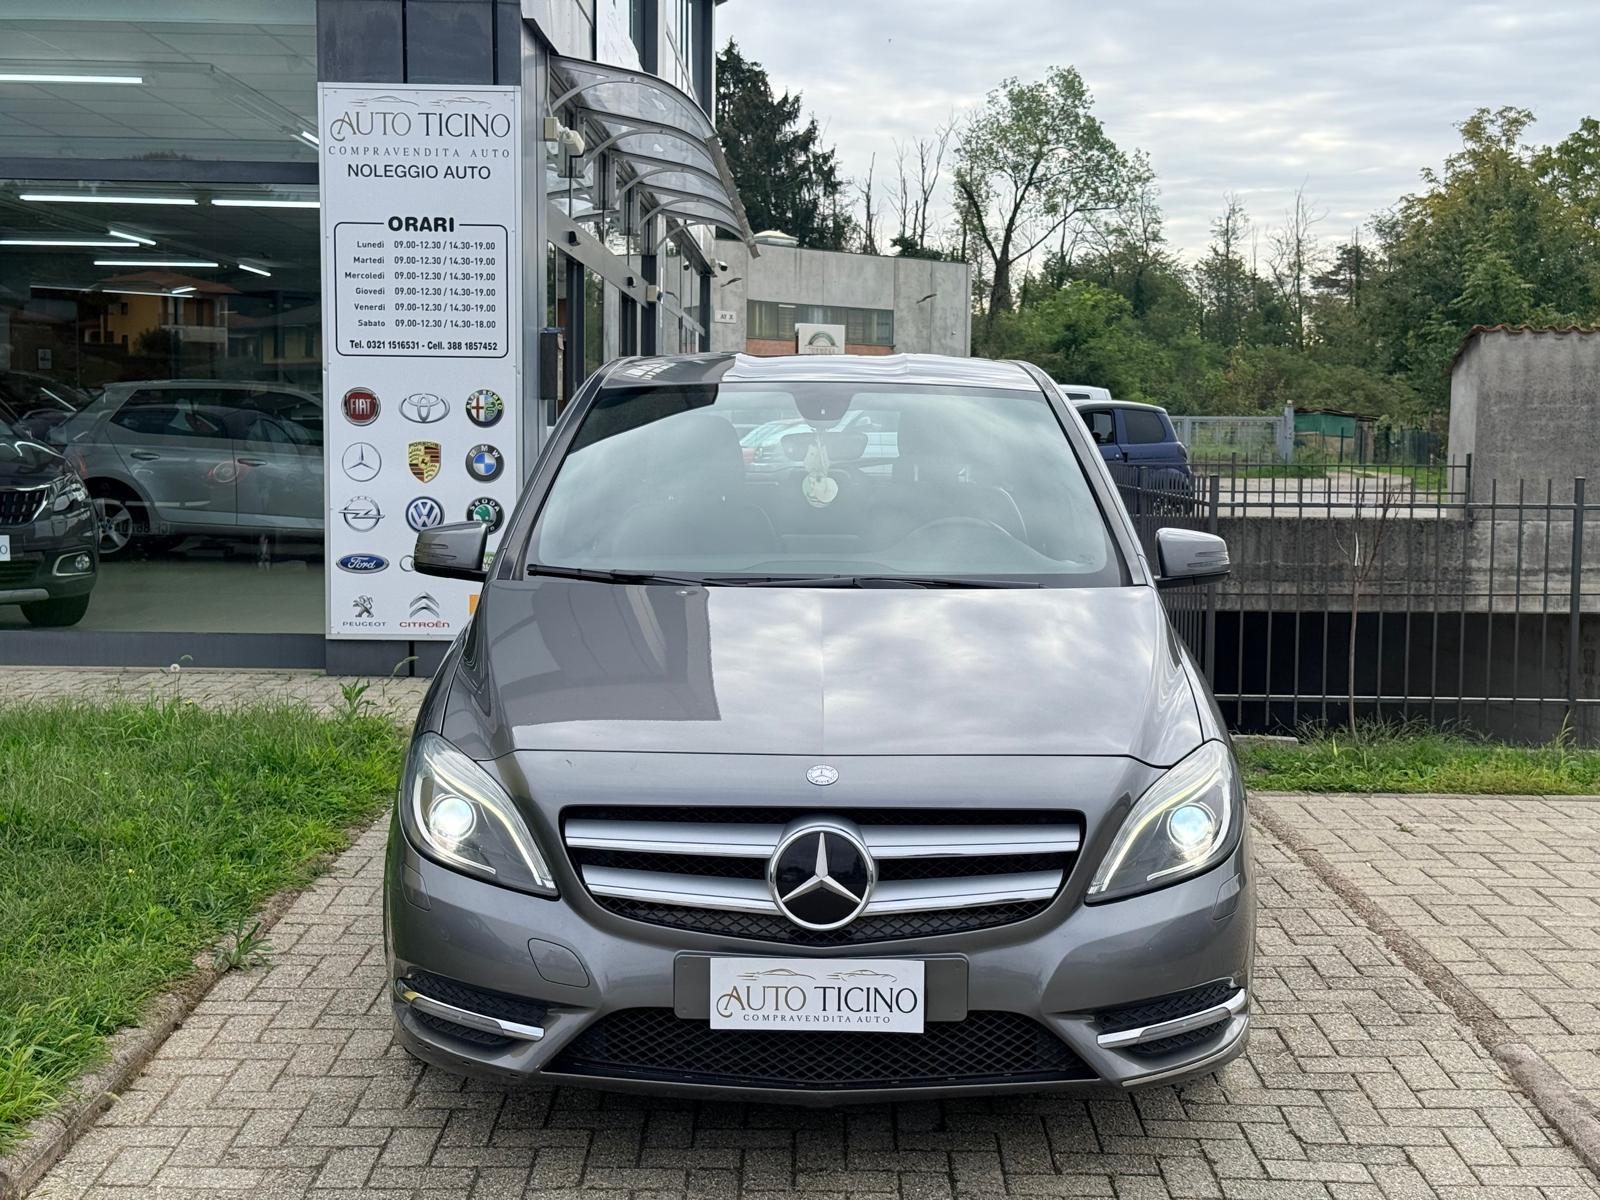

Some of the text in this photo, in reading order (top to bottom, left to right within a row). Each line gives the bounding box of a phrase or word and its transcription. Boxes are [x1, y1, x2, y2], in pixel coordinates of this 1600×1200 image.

[330, 111, 511, 141] AUTO TICINO
[329, 146, 510, 158] COMPRAVENDITA AUTO
[348, 164, 491, 179] NOLEGGIO AUTO
[388, 216, 455, 233] ORARI
[394, 241, 442, 250] 09.00-12.30
[394, 256, 442, 265] 09.00-12.30
[394, 272, 442, 280] 09.00-12.30
[394, 287, 442, 296] 09.00-12.30
[394, 303, 442, 312] 09.00-12.30
[358, 319, 386, 328] Sabato
[395, 319, 442, 328] 09.00-12.30
[350, 340, 364, 349] Tel.
[367, 340, 385, 349] 0321
[388, 341, 419, 350] 1516531
[427, 341, 444, 350] Cell.
[447, 341, 462, 350] 388
[465, 342, 497, 351] 1857452
[351, 399, 371, 414] FIAT
[470, 445, 500, 458] BMW
[347, 557, 376, 569] Ford
[716, 986, 918, 1018] AUTO TICINO
[743, 1014, 891, 1024] COMPRAVENDITA AUTO
